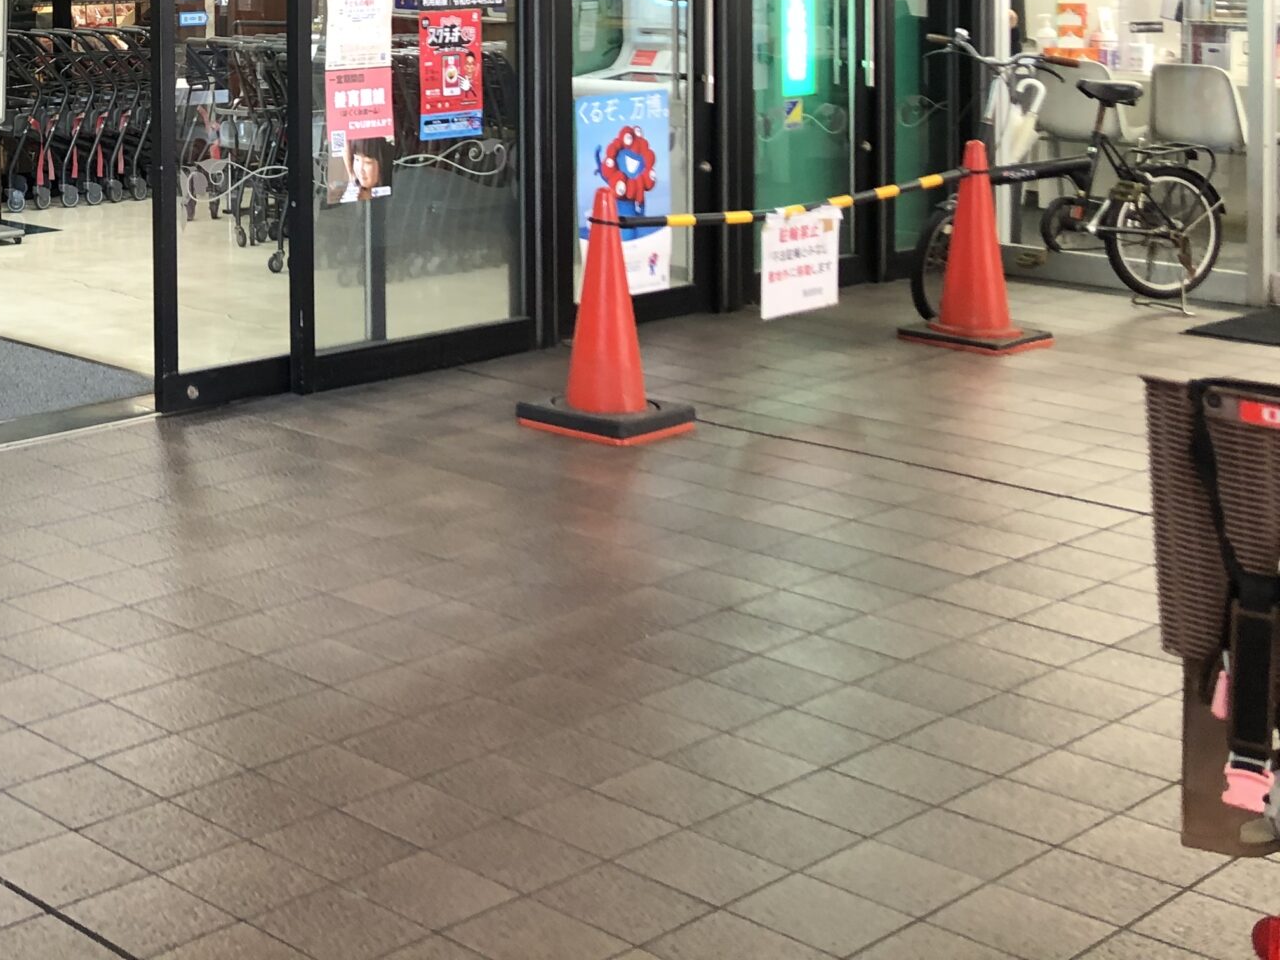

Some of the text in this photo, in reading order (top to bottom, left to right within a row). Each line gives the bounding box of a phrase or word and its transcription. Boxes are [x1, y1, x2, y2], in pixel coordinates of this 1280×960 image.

[578, 93, 669, 124] くるぞ、万博。
